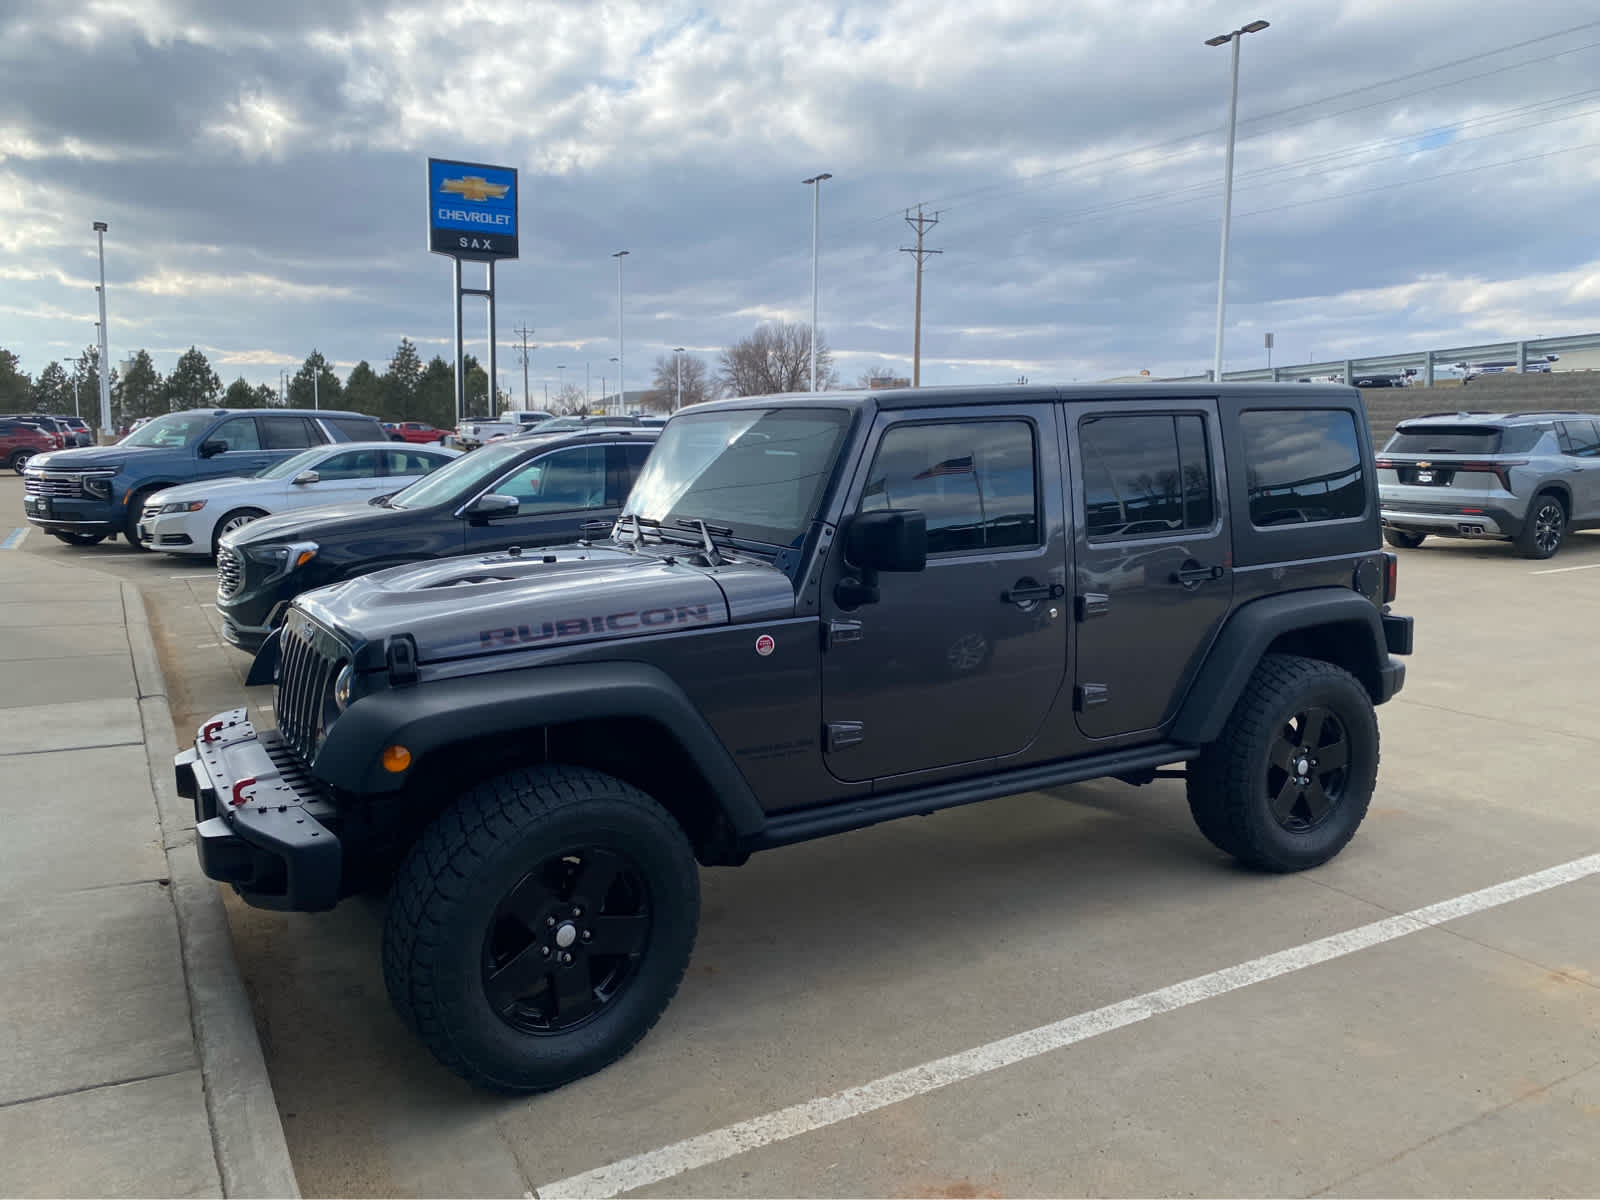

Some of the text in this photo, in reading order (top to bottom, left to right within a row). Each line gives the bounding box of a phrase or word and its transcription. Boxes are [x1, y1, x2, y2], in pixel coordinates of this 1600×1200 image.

[438, 208, 511, 225] CHEVROLET
[459, 237, 492, 249] SAX
[479, 604, 710, 648] RUBICON
